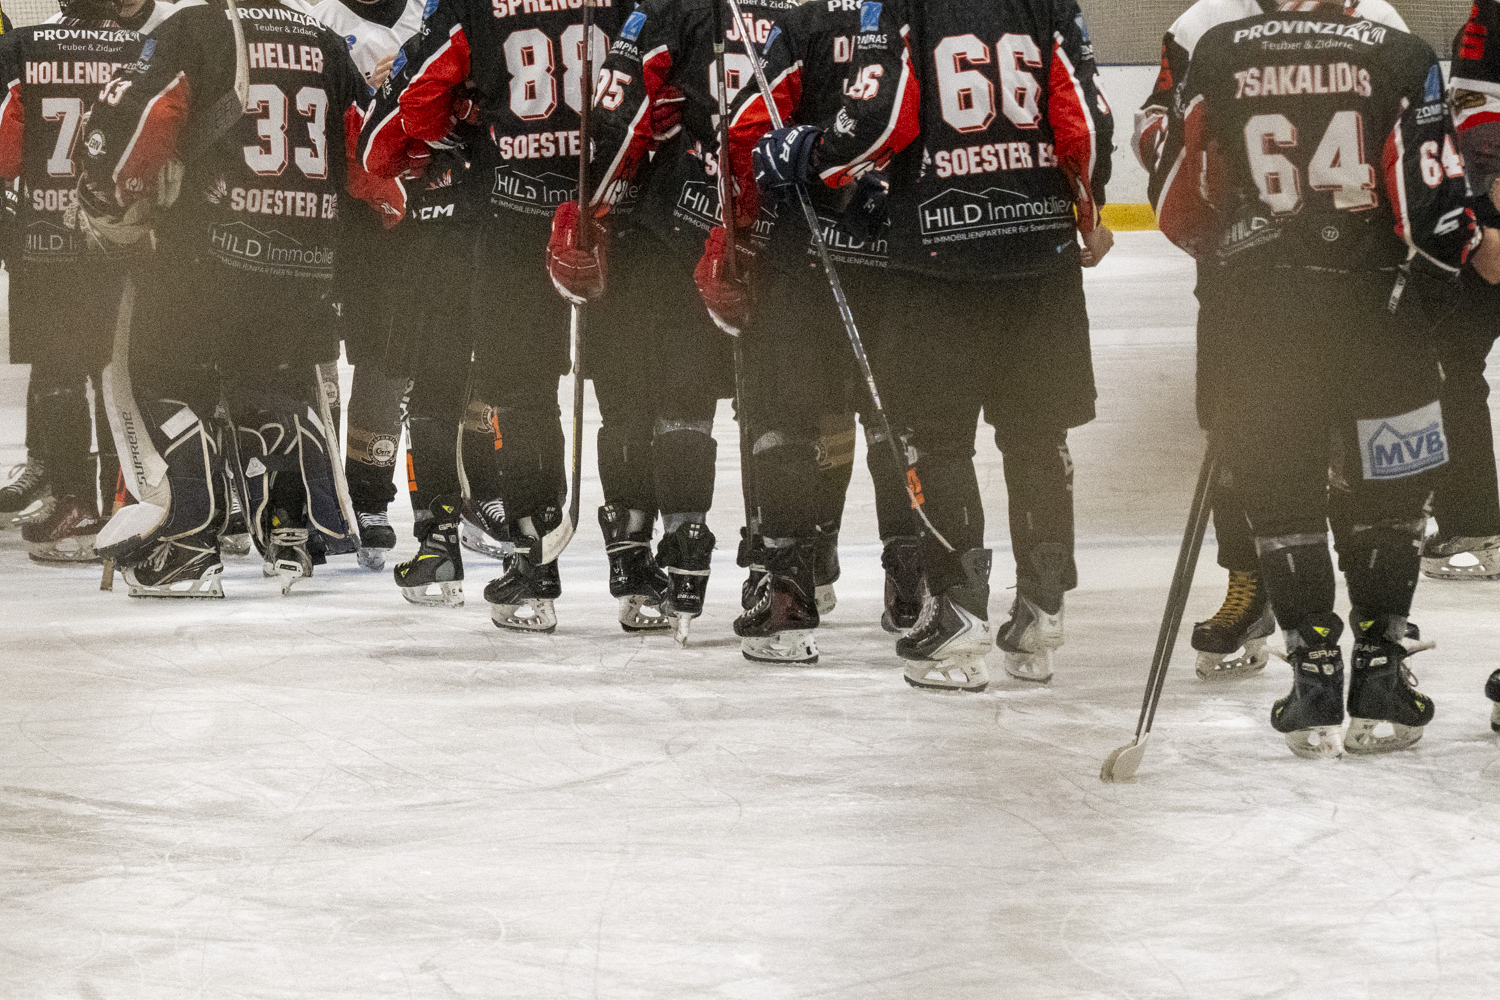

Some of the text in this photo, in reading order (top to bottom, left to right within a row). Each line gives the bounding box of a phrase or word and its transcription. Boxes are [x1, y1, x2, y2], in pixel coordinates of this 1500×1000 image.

[34, 29, 135, 42] PROVINZIAL
[254, 24, 318, 38] Teuber & Zidaric
[726, 13, 774, 44] JÄG
[1233, 20, 1376, 46] PROVINZIAL
[57, 44, 86, 52] Teuber
[249, 42, 324, 74] HELLER
[1262, 40, 1301, 51] Teuber
[1304, 41, 1313, 50] &
[503, 24, 611, 121] 88
[934, 33, 1043, 133] 66
[1234, 62, 1372, 99] TSAKALIDIS
[243, 84, 329, 180] 33
[935, 142, 1033, 178] SOESTER
[1244, 110, 1378, 216] 64
[1420, 134, 1465, 188] 64
[231, 187, 318, 218] SOESTER
[498, 174, 537, 200] HILD
[419, 204, 454, 220] CM
[925, 204, 982, 229] HILD
[212, 229, 261, 257] HILD
[934, 226, 1017, 243] IMMOBILIENPARTNER
[123, 410, 146, 487] SUPREME
[1375, 431, 1444, 465] MVB
[1354, 643, 1380, 652] RAF
